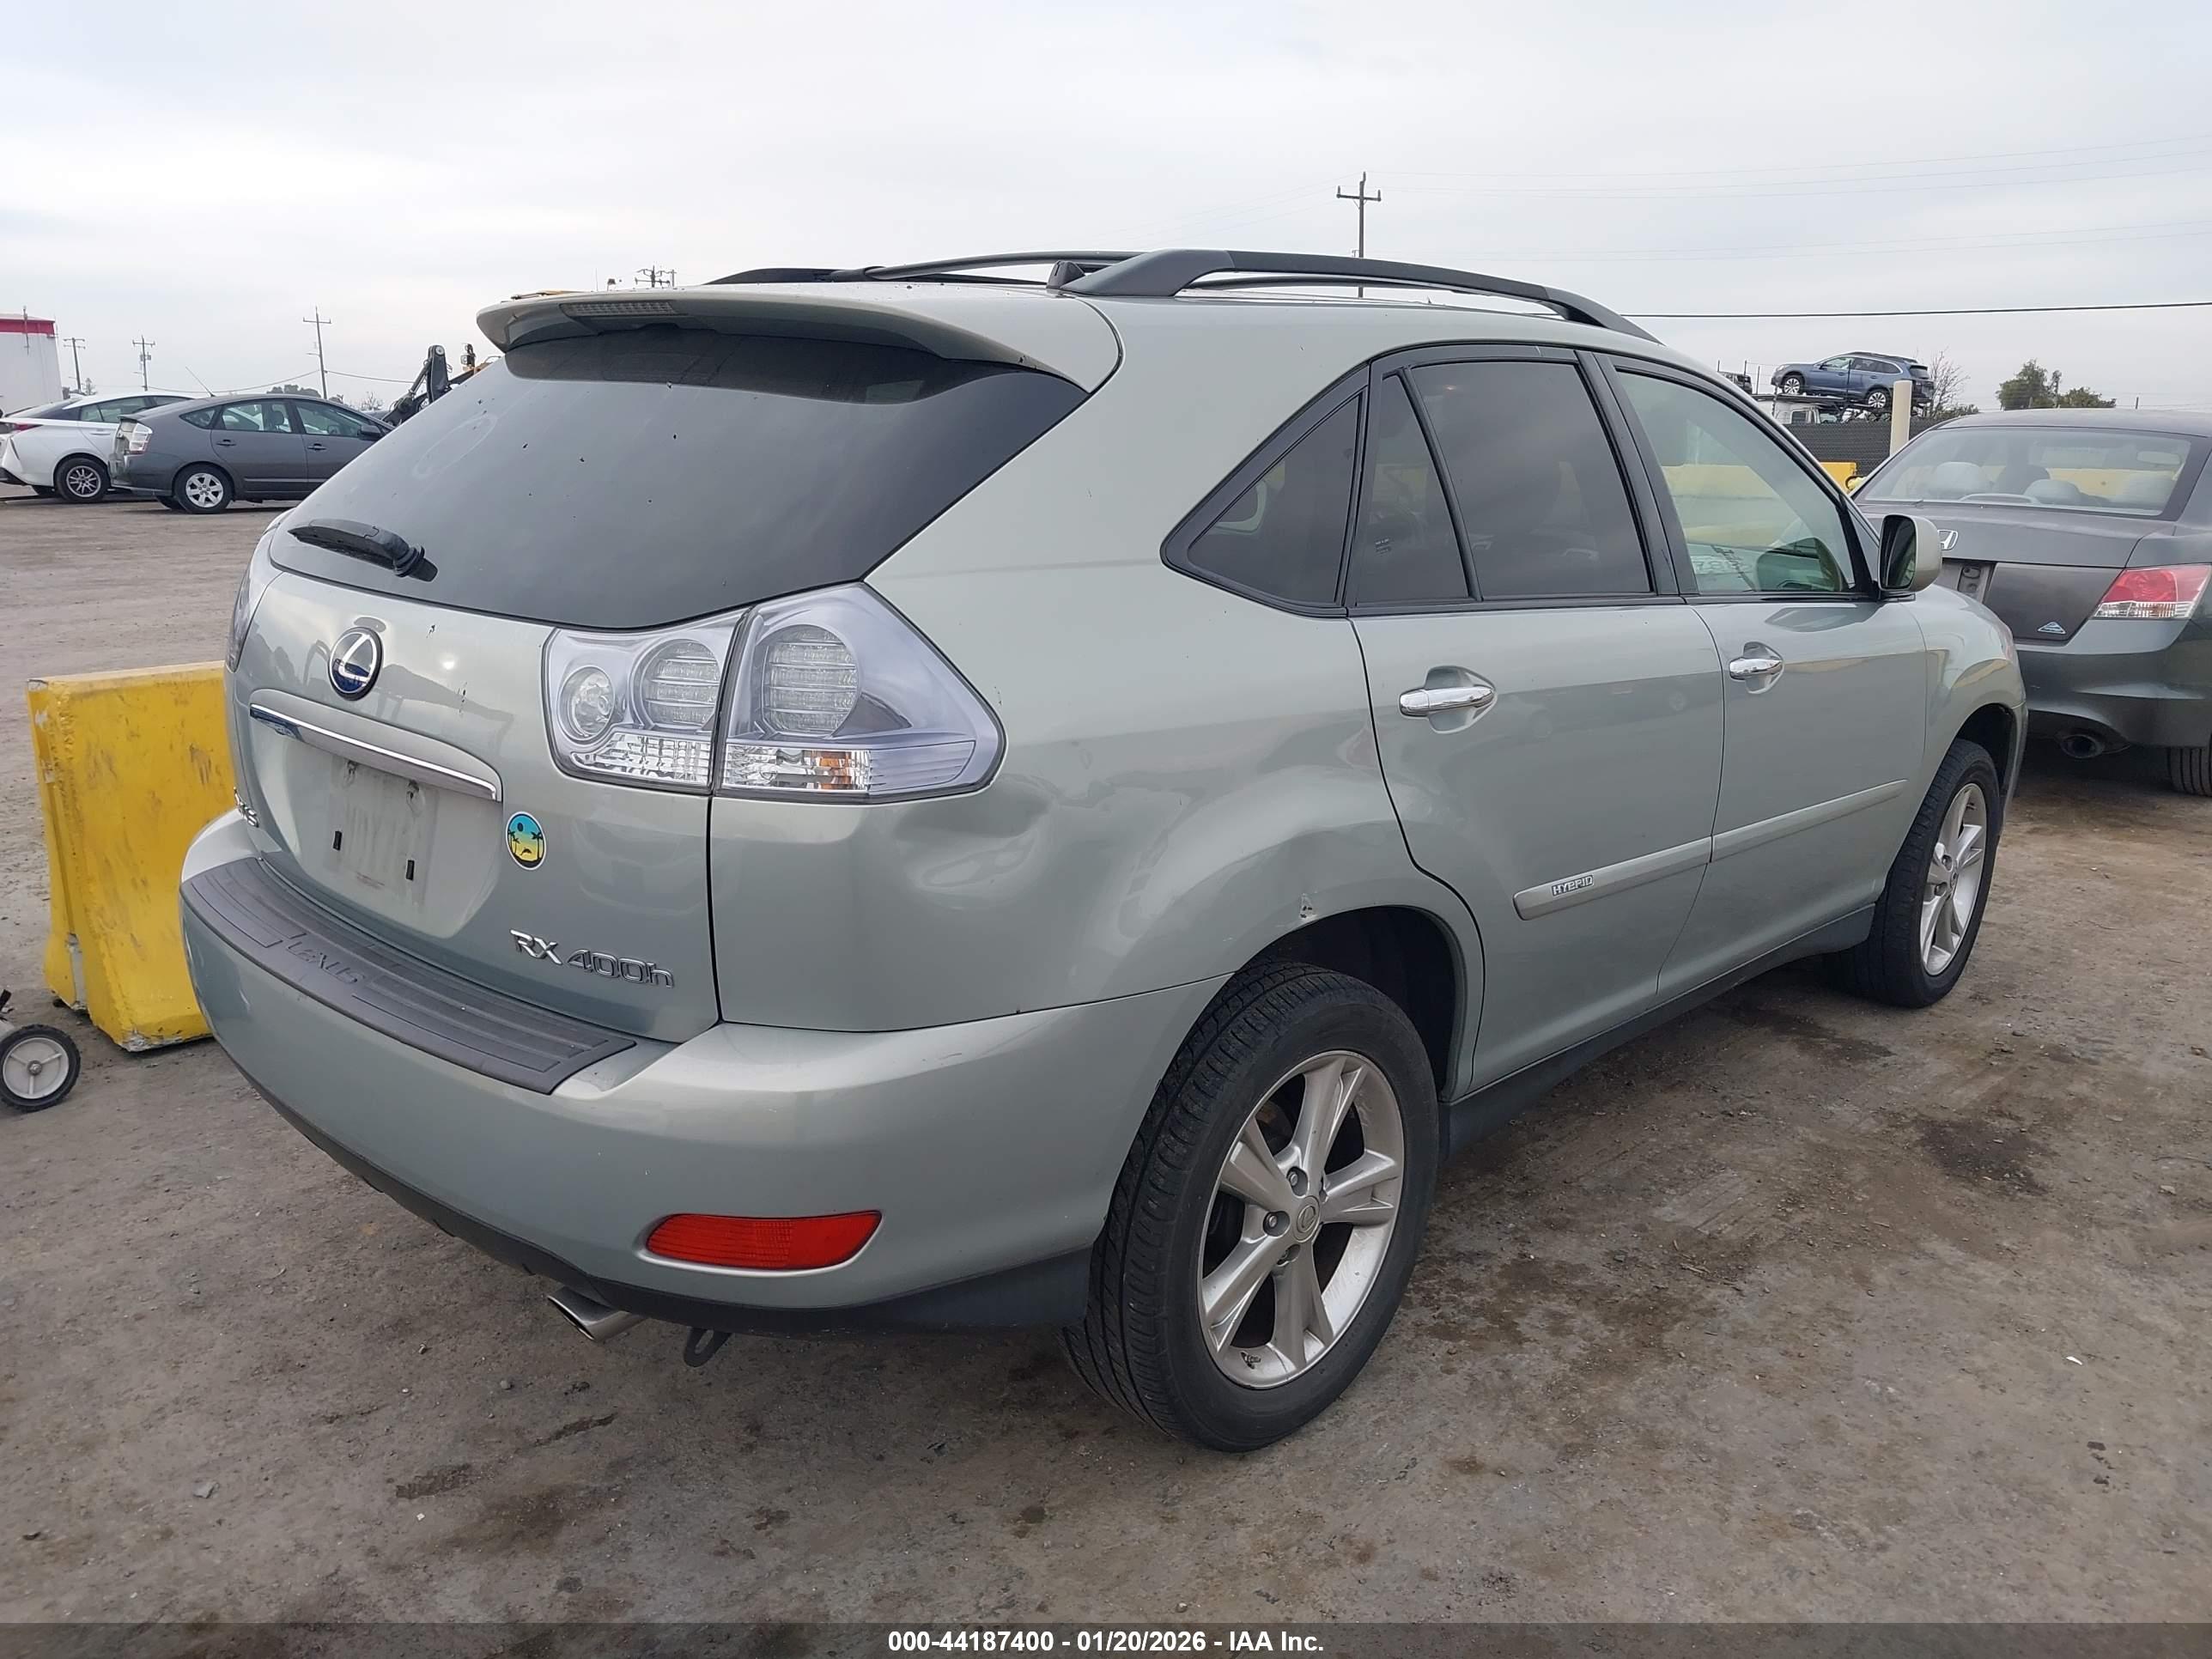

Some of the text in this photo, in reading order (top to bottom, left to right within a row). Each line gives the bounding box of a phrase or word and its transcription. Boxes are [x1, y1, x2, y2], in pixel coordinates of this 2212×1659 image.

[1553, 876, 1593, 895] HYBRID
[286, 941, 366, 983] LEXUS
[509, 929, 674, 988] RX 400h
